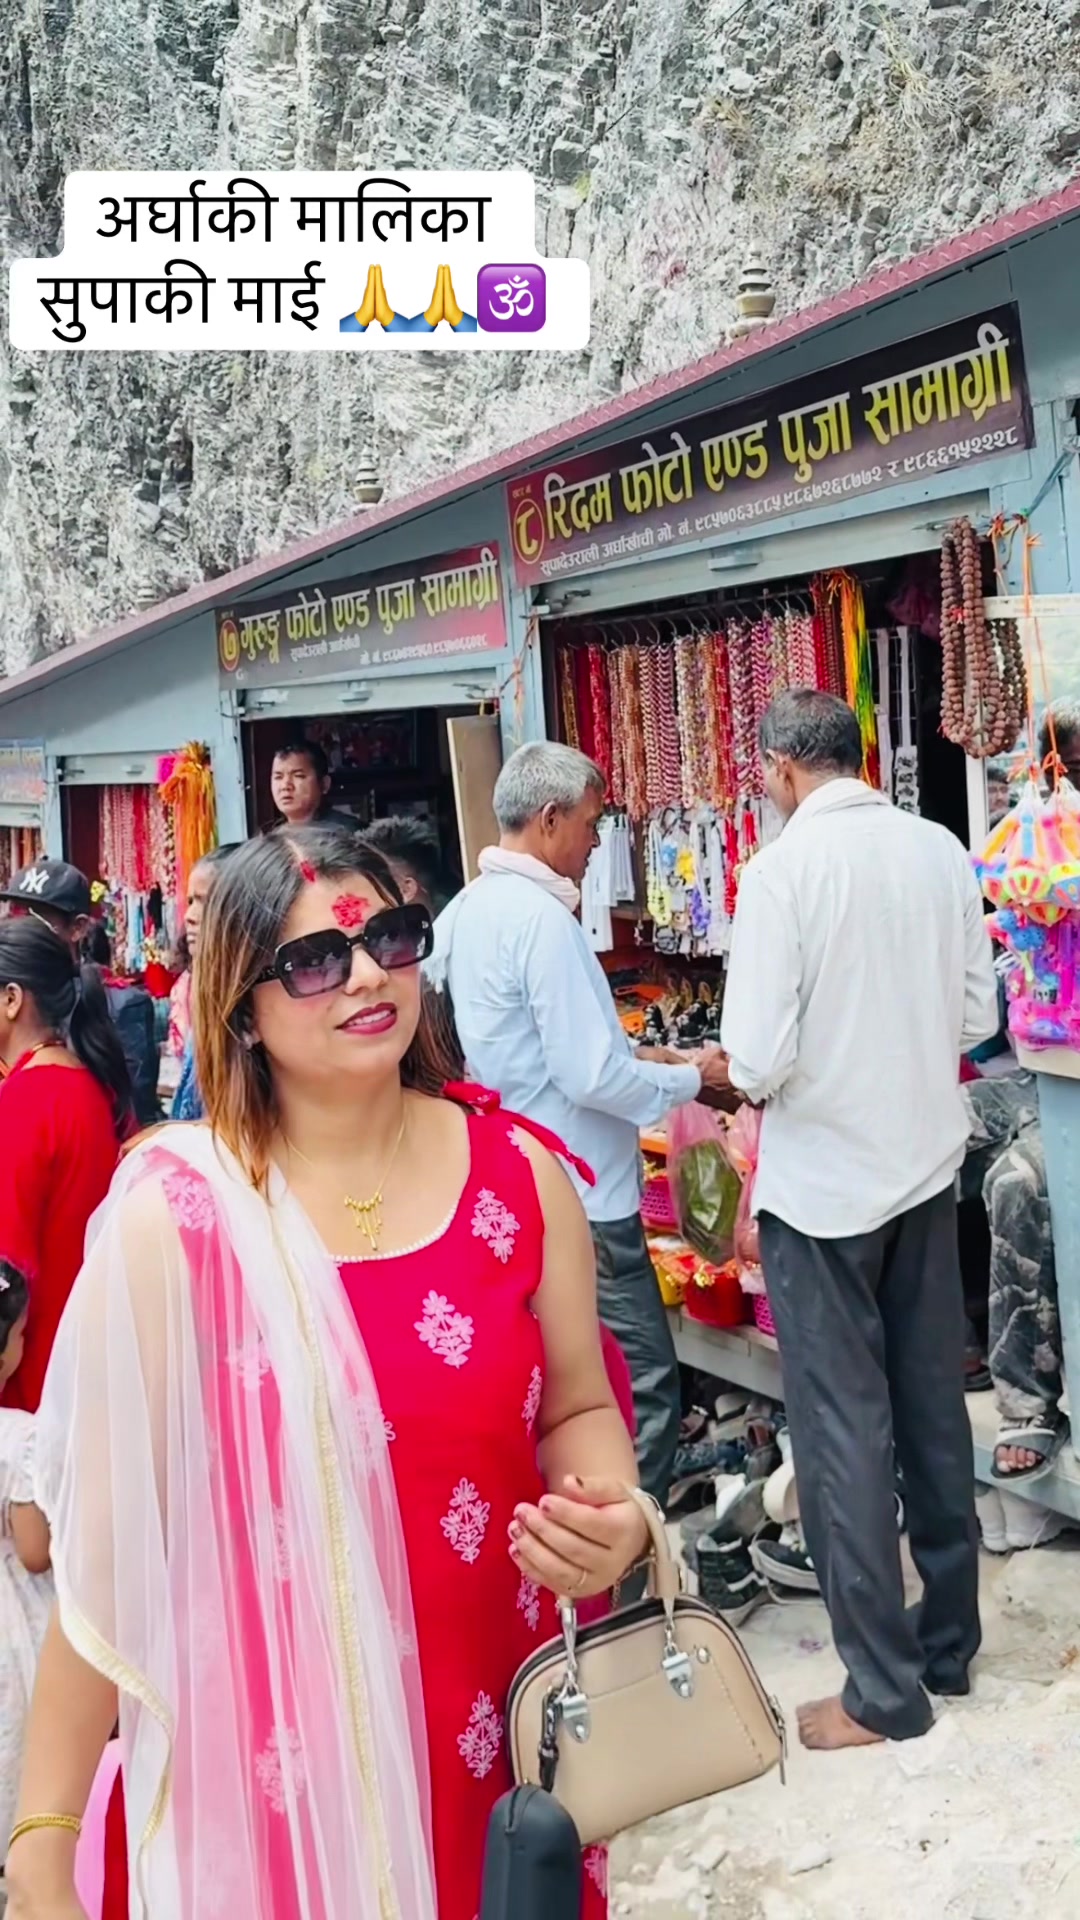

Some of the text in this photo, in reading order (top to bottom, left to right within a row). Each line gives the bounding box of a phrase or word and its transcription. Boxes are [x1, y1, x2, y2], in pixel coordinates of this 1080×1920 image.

[543, 322, 1012, 540] रिदम फोटो एण्ड पुजा सामाग्री
[285, 587, 328, 641] फोटो
[331, 588, 371, 632] एण्ड
[375, 578, 416, 635] पुजा
[421, 546, 498, 617] सामाग्री
[19, 867, 49, 894] NY
